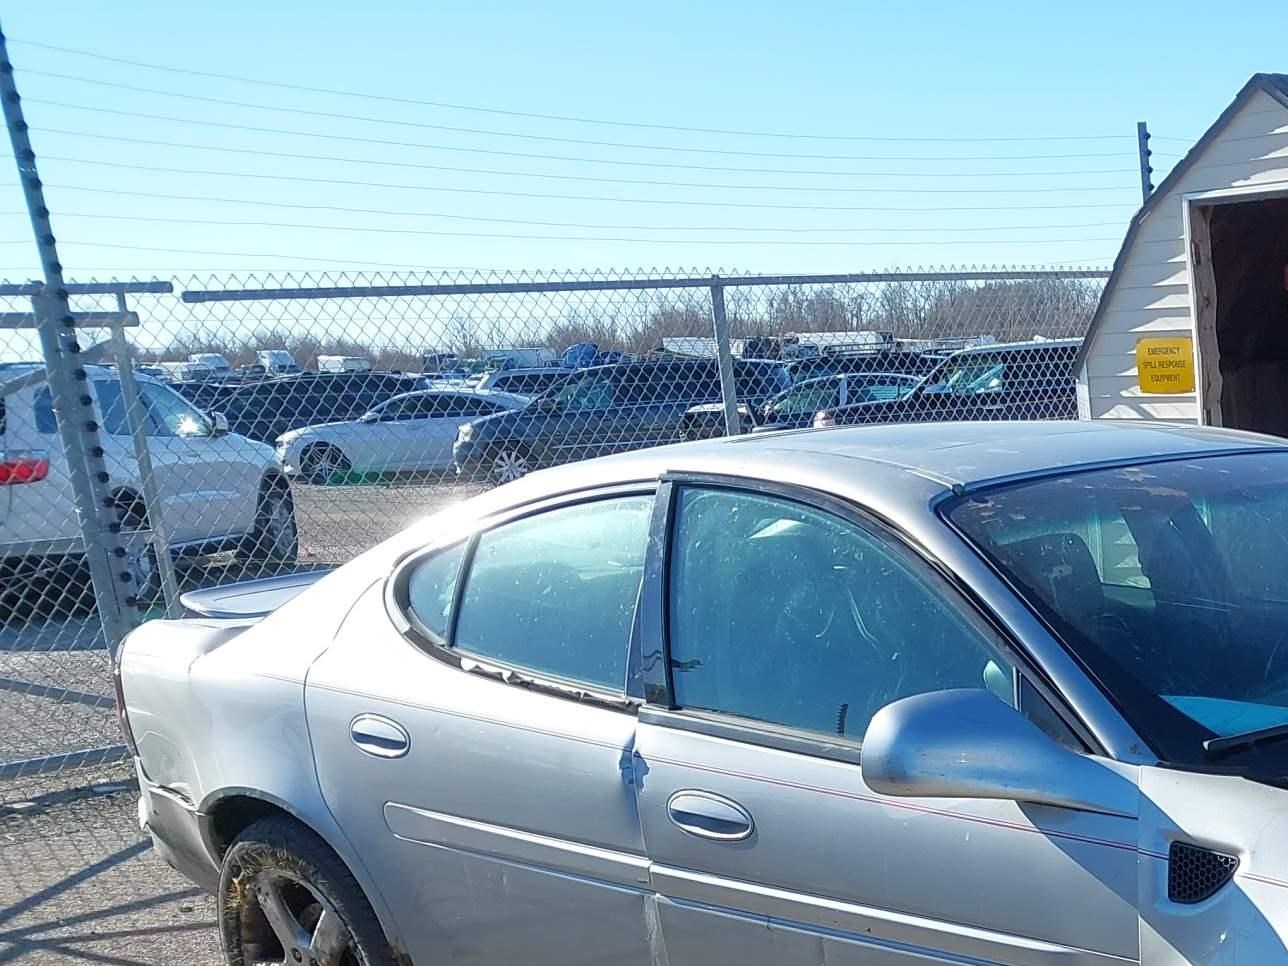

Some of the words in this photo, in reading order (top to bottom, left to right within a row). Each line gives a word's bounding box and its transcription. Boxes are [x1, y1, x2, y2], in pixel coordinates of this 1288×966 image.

[1147, 346, 1180, 356] EMERGENCY
[1143, 360, 1157, 369] SPILL
[1158, 359, 1187, 369] RESPONSE
[1150, 373, 1181, 383] EQUIPMENT
